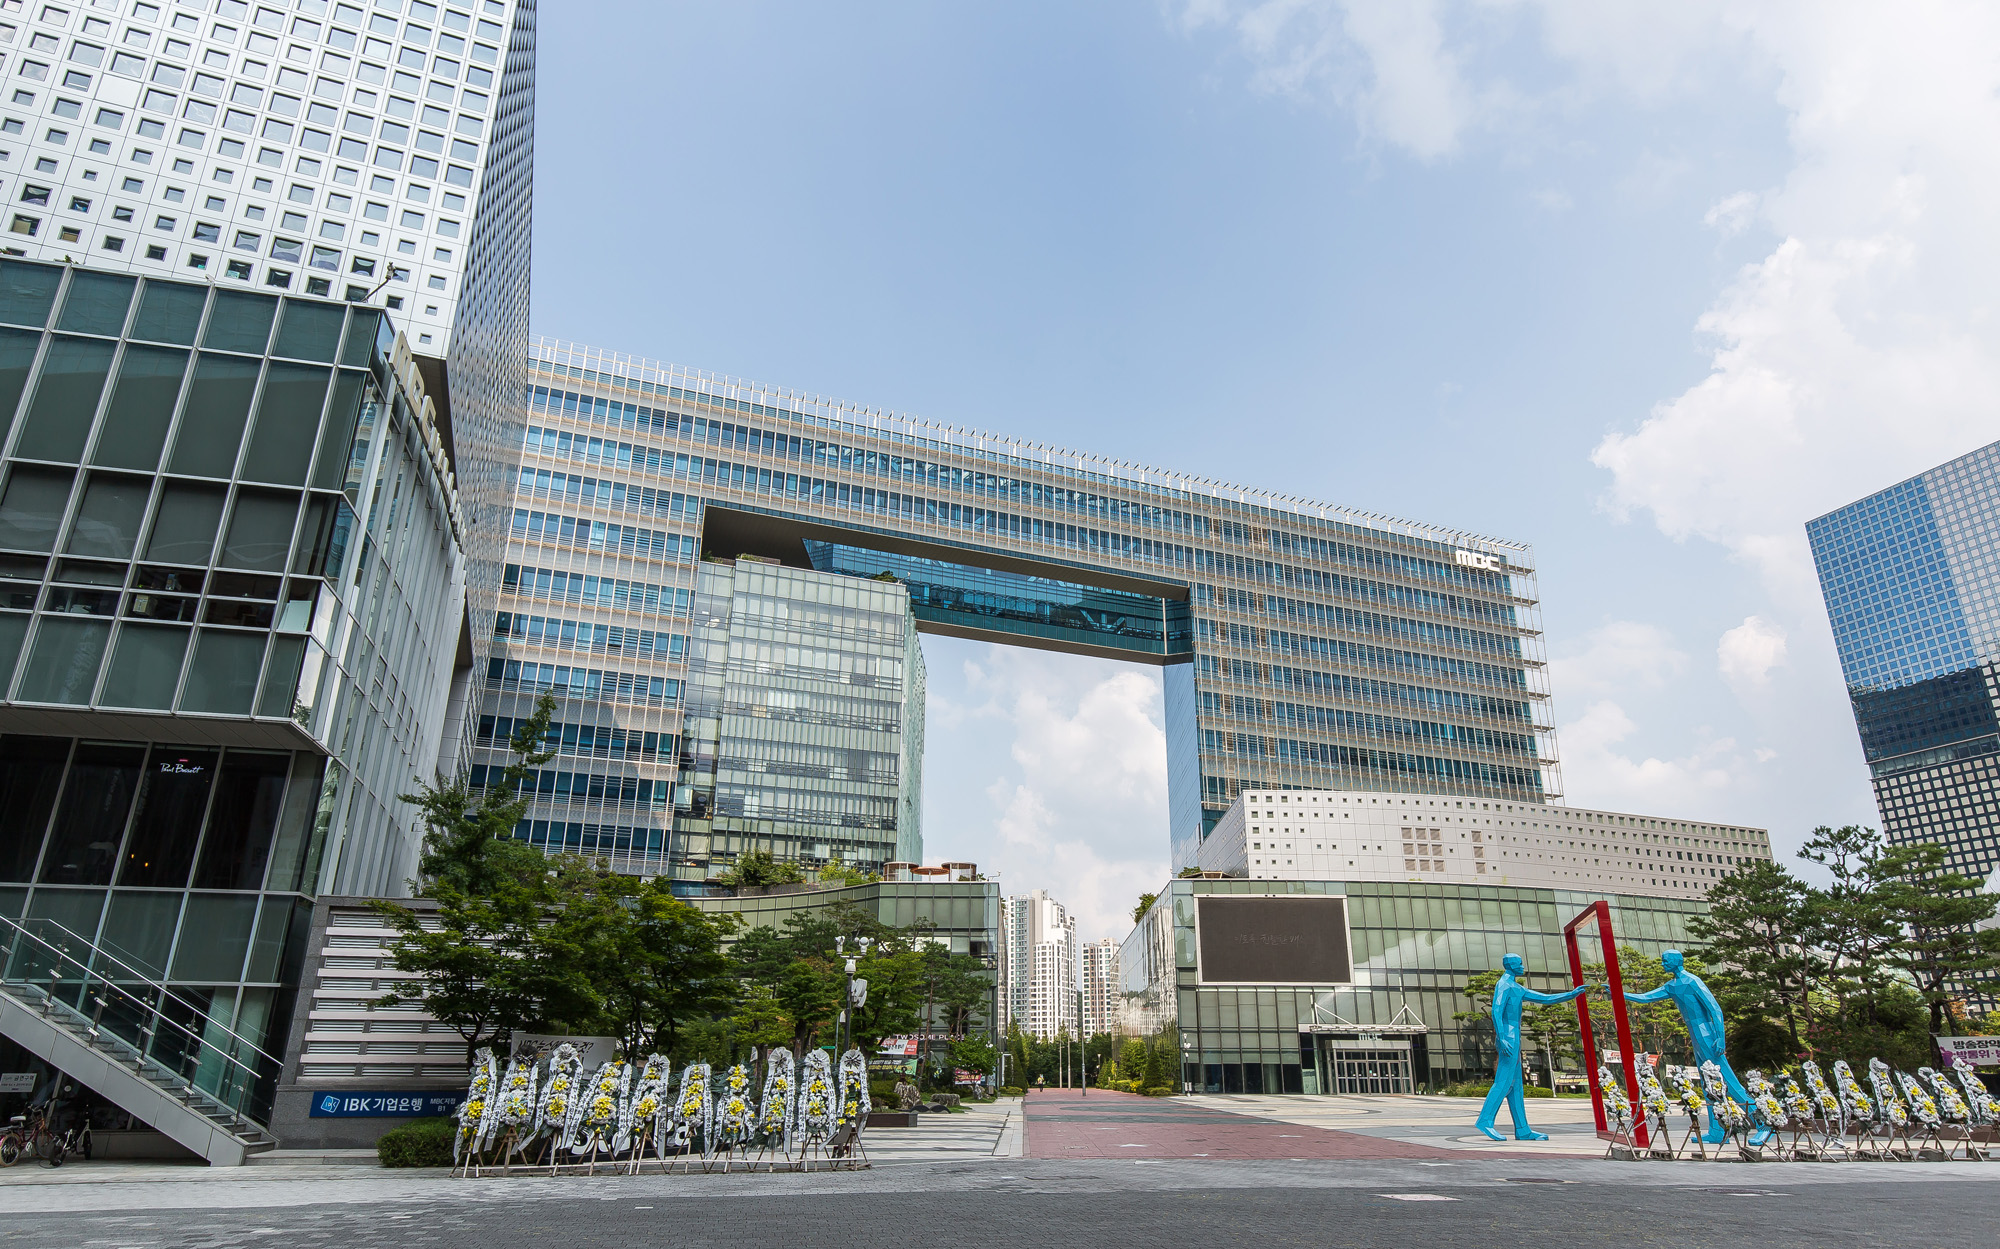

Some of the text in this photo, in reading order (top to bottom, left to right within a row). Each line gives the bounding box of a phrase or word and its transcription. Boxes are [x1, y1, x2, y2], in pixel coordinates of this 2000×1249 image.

[1455, 550, 1500, 572] MBC
[343, 1097, 423, 1112] IBK 기업은행
[429, 1097, 456, 1105] MBC지점
